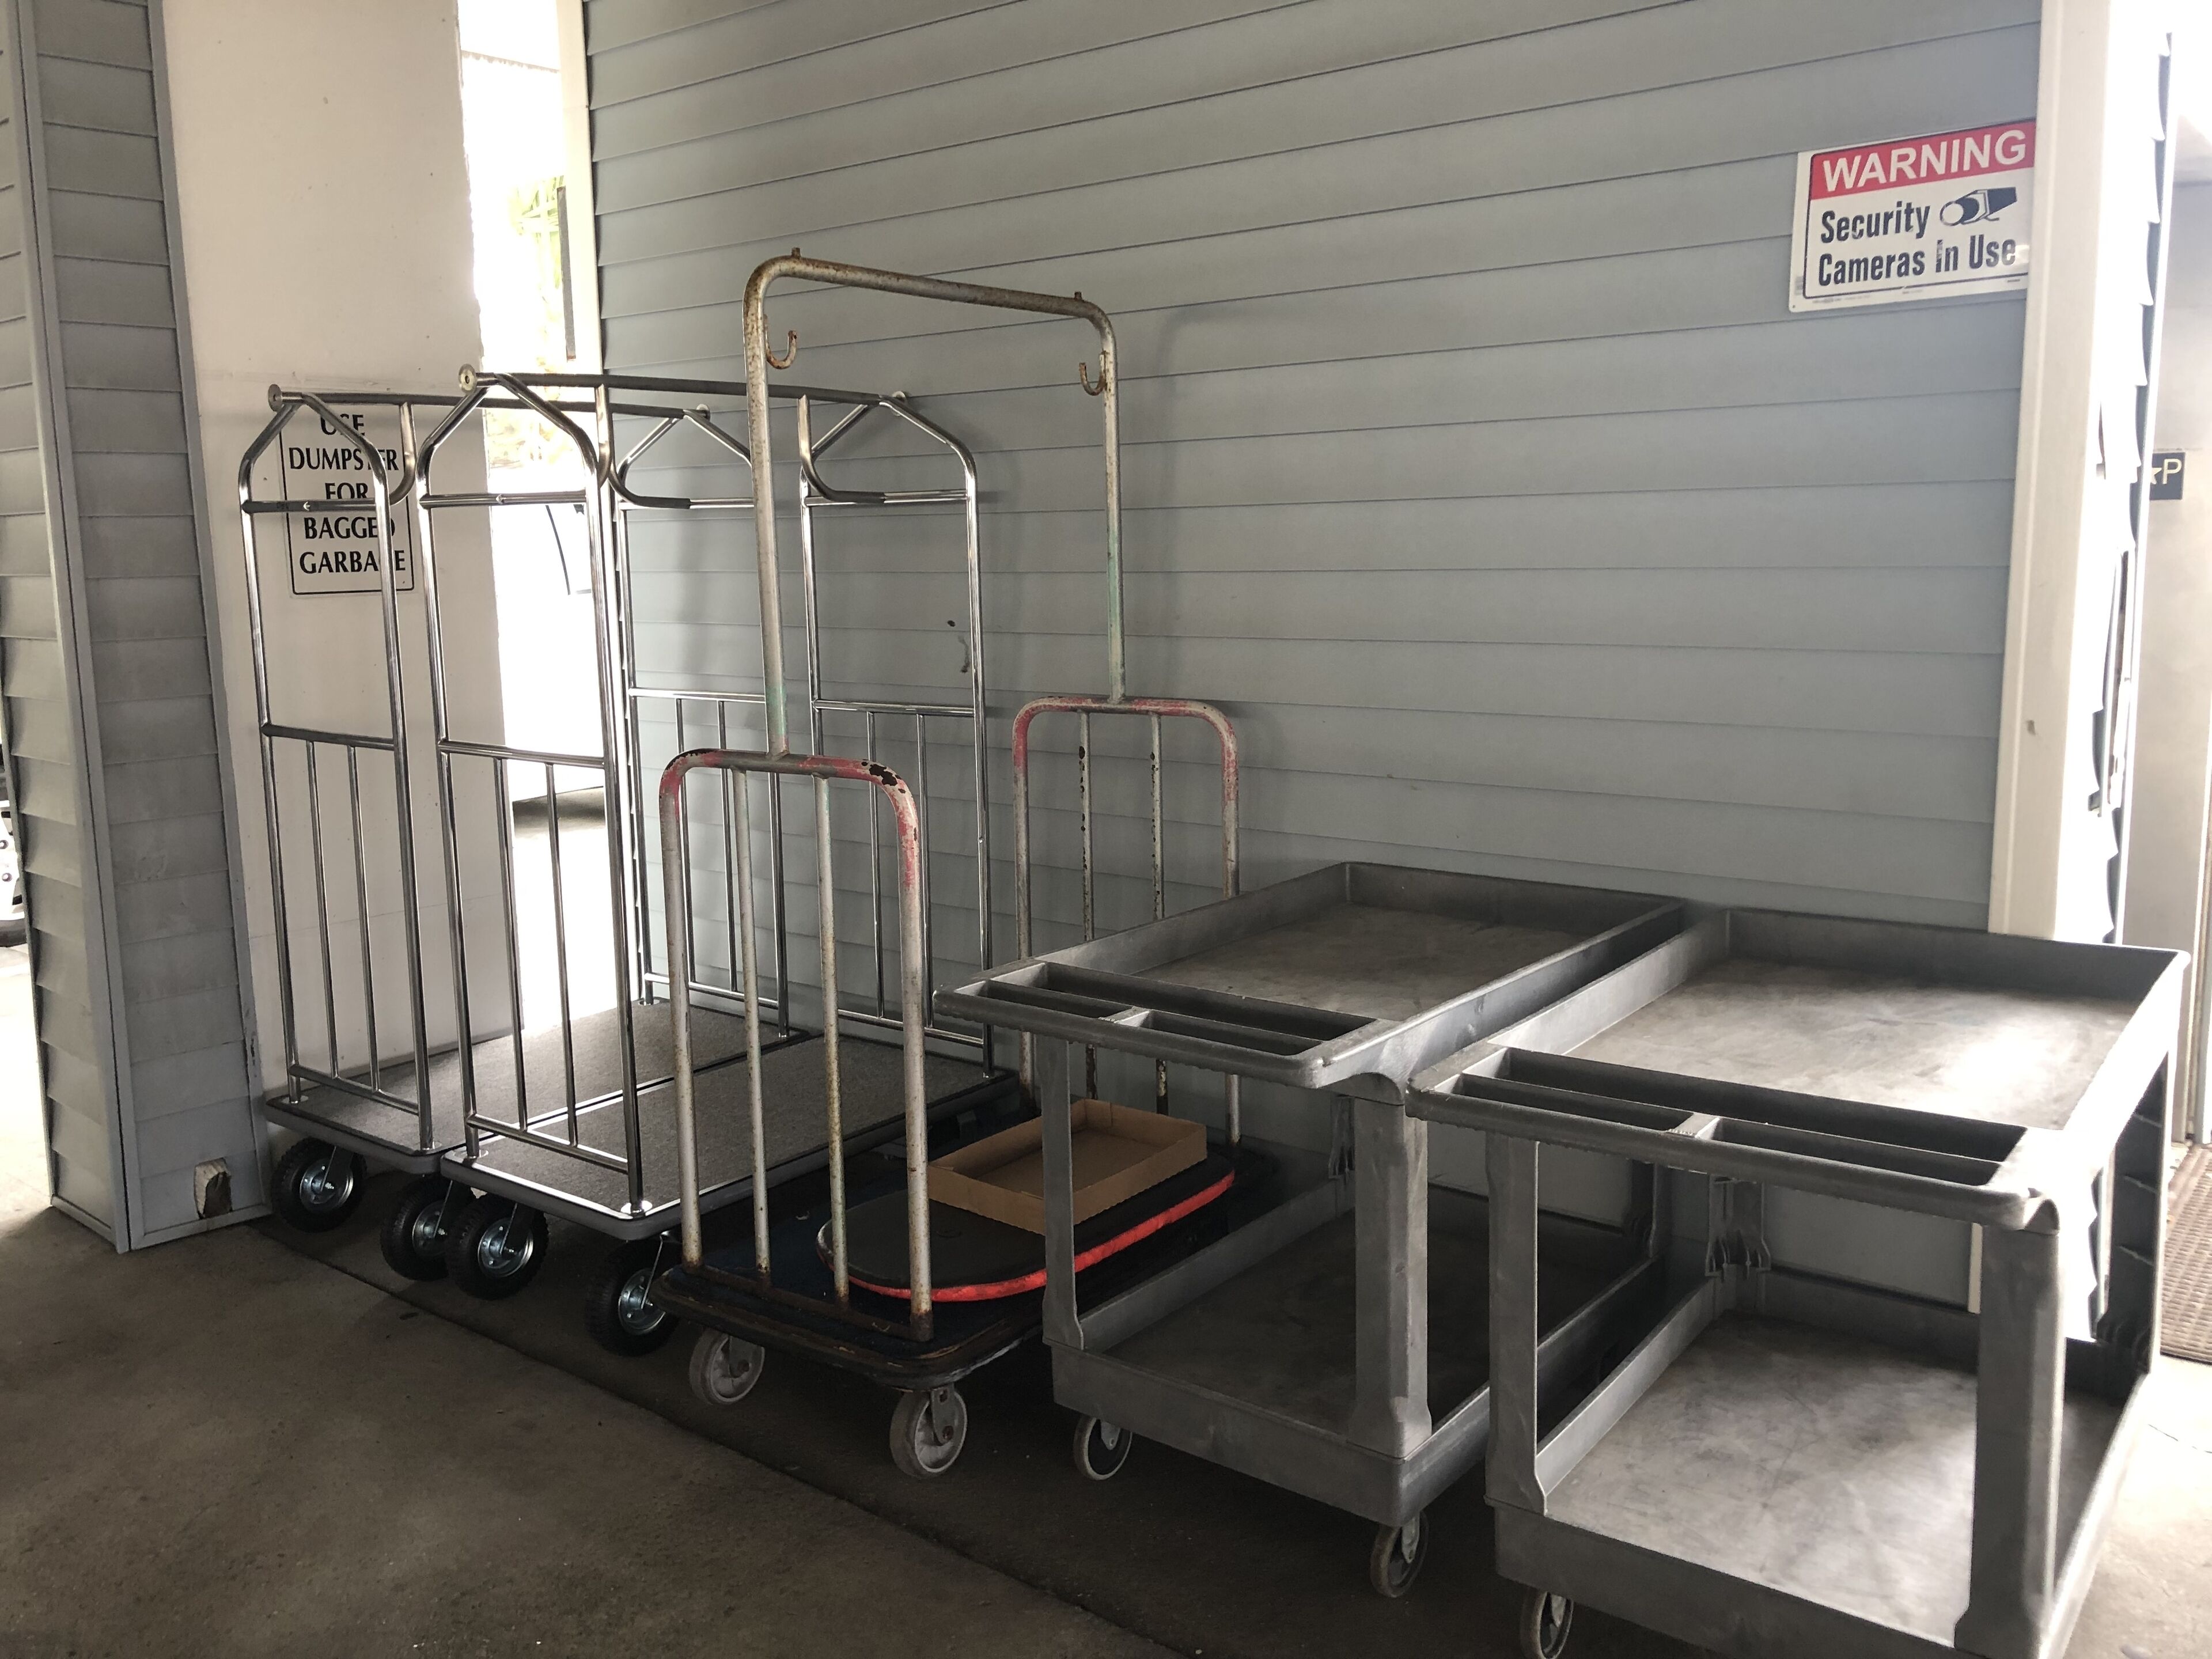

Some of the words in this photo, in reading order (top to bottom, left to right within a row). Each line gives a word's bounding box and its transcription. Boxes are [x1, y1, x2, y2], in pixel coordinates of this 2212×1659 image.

[1823, 129, 2027, 192] WARNING
[1820, 200, 1930, 244] Security
[1818, 250, 1926, 286] Cameras
[1936, 239, 1959, 273] in
[1969, 234, 2016, 270] Use
[320, 413, 365, 436] UE
[289, 447, 399, 471] DUMPSR
[324, 482, 368, 500] FOR
[304, 516, 396, 539] BAGGE
[300, 550, 406, 574] GARBAE
